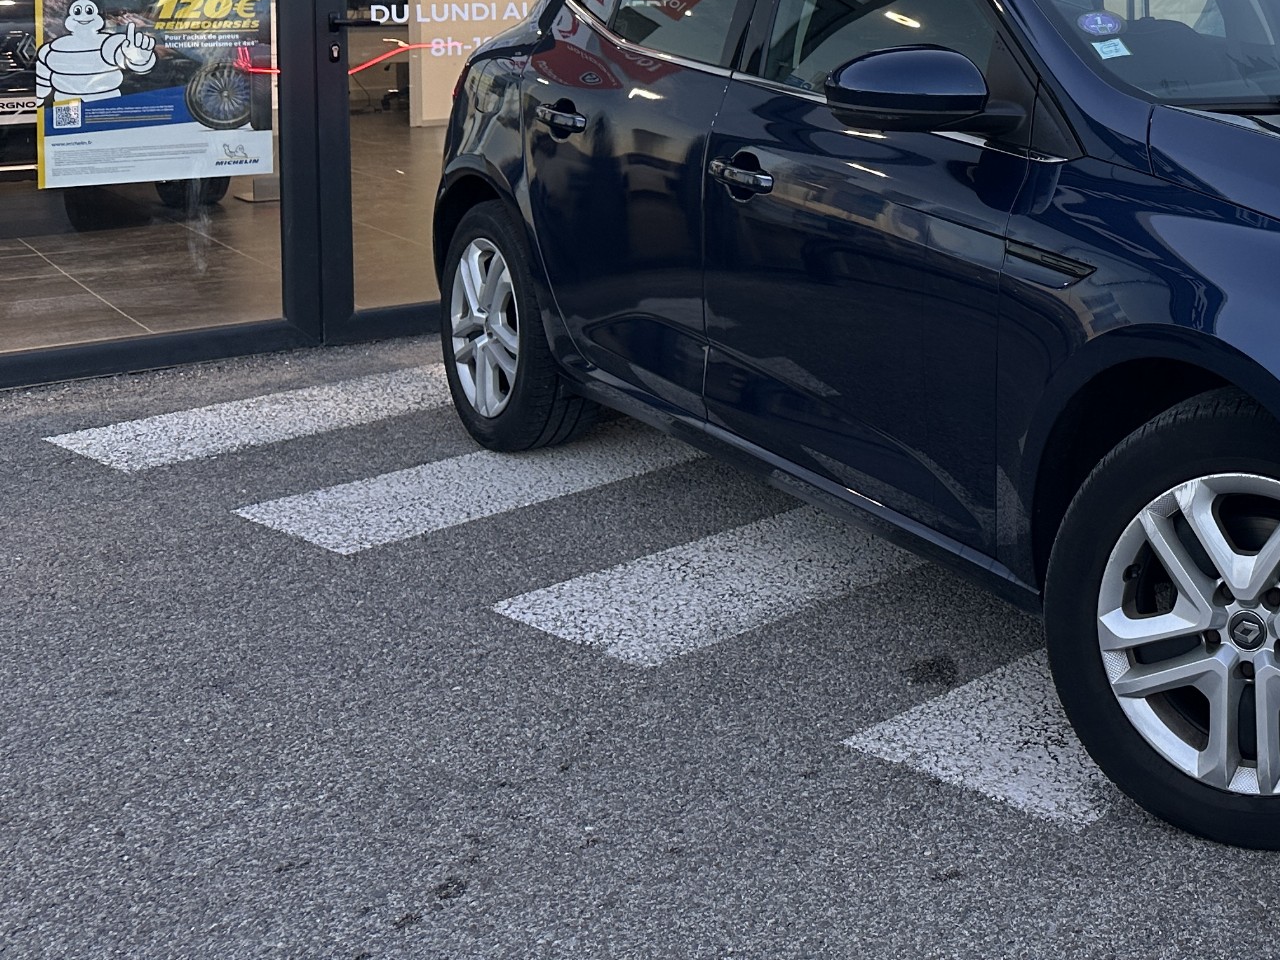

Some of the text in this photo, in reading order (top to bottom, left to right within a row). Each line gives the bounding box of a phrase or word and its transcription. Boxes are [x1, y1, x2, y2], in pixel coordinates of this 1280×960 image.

[370, 4, 410, 24] DU
[416, 2, 497, 23] LUNDI
[154, 19, 260, 30] REMBOURSÉS
[182, 33, 207, 41] l'achat
[431, 36, 492, 57] 8h-1
[215, 158, 260, 166] MICHELIN
